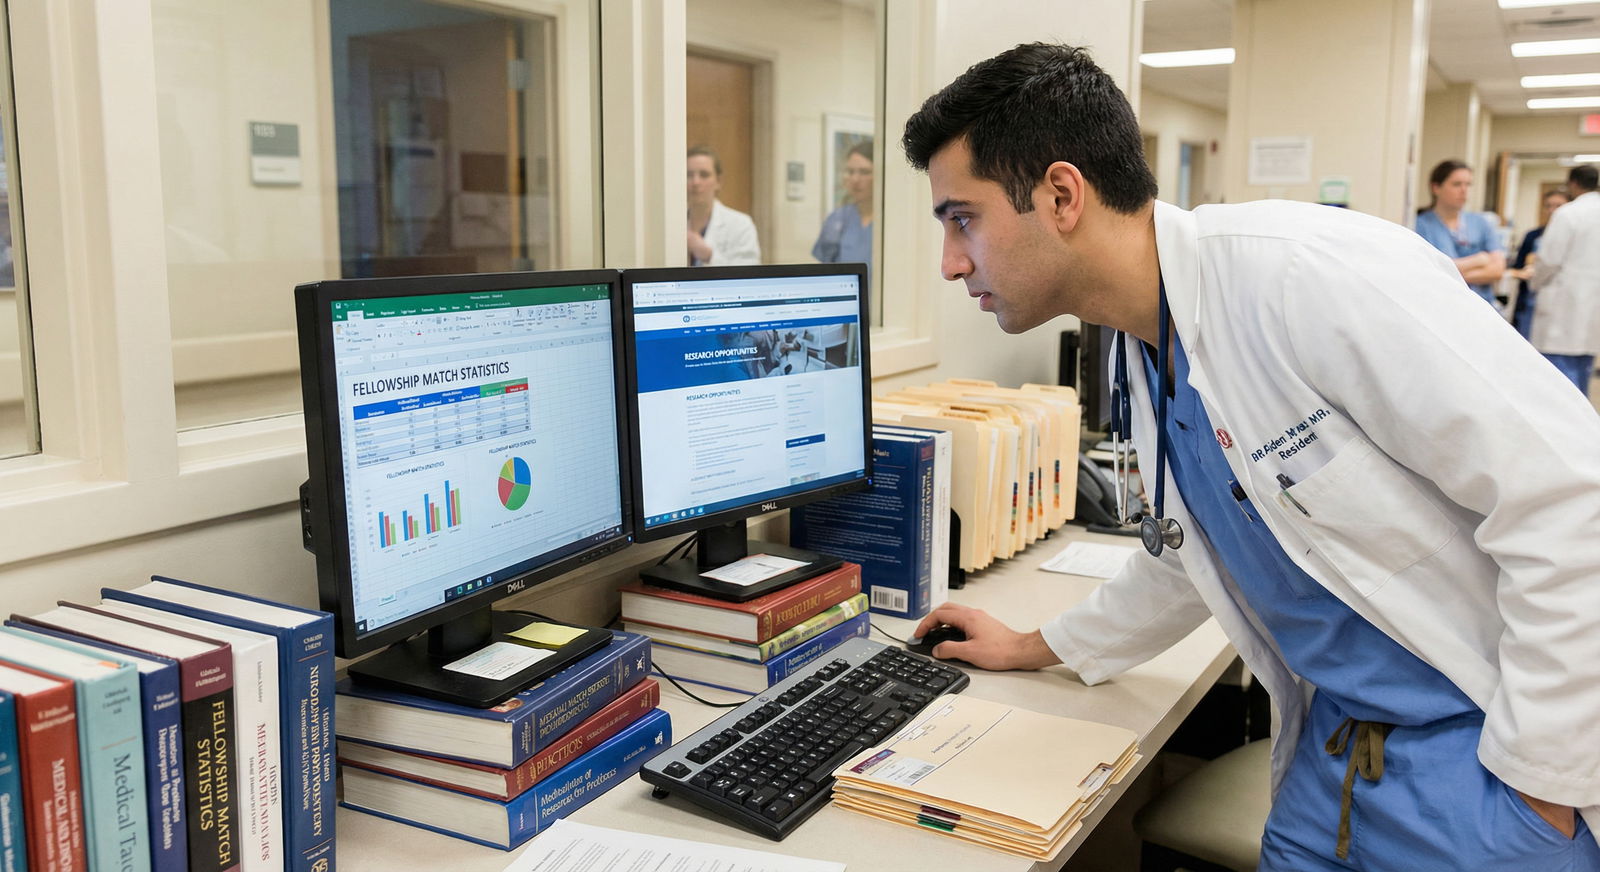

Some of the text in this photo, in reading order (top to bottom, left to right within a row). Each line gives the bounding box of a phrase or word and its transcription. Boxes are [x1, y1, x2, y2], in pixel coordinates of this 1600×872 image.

[353, 361, 510, 397] FELLOWSHIP MATCH STATISTICS
[761, 502, 777, 512] DELL
[507, 579, 526, 593] DELL
[113, 753, 136, 831] Medical
[197, 738, 213, 831] STATISTICS
[212, 700, 231, 866] FELLOWSHIP MATCH
